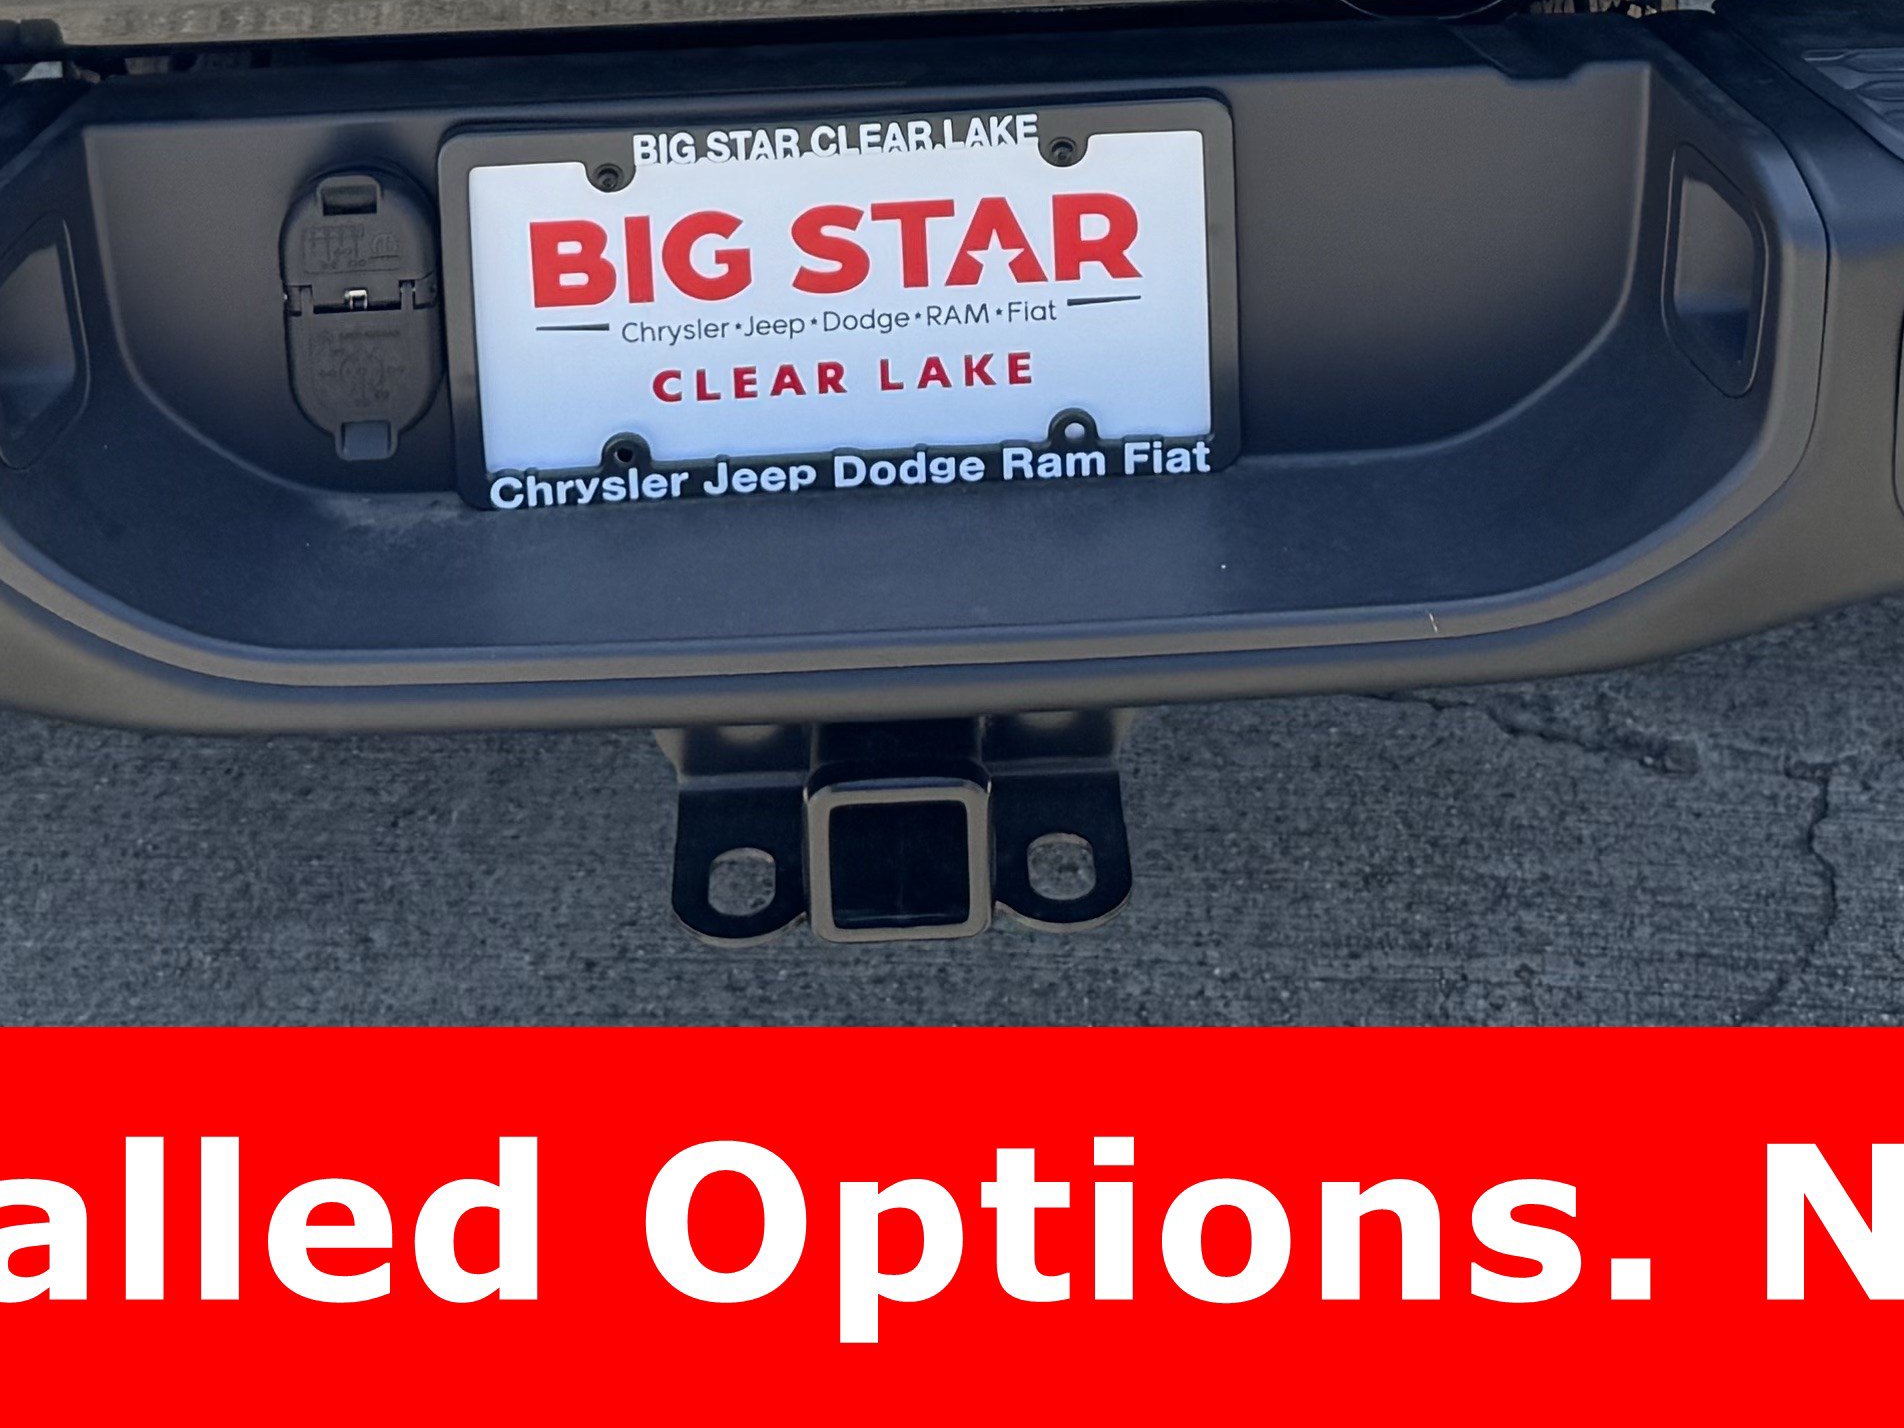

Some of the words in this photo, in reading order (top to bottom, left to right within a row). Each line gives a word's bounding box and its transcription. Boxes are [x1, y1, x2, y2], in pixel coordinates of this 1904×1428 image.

[632, 131, 697, 166] BIG
[705, 128, 801, 163] STAR
[809, 119, 934, 158] CLEAR
[942, 112, 1040, 150] LAKE
[528, 209, 753, 309] BIG
[790, 191, 1144, 296] STAR
[621, 319, 731, 346] Chrysler
[743, 315, 806, 338] Jeep
[822, 307, 911, 334] Dodge
[926, 303, 990, 327] RAM
[1007, 299, 1058, 323] Fiat
[652, 361, 848, 403] CLEAR
[879, 351, 1033, 392] LAKE
[489, 467, 690, 510] Chrysler
[702, 461, 818, 495] Jeep
[832, 451, 986, 488] Dodge
[1002, 446, 1107, 481] Ram
[1123, 440, 1211, 475] Fiat
